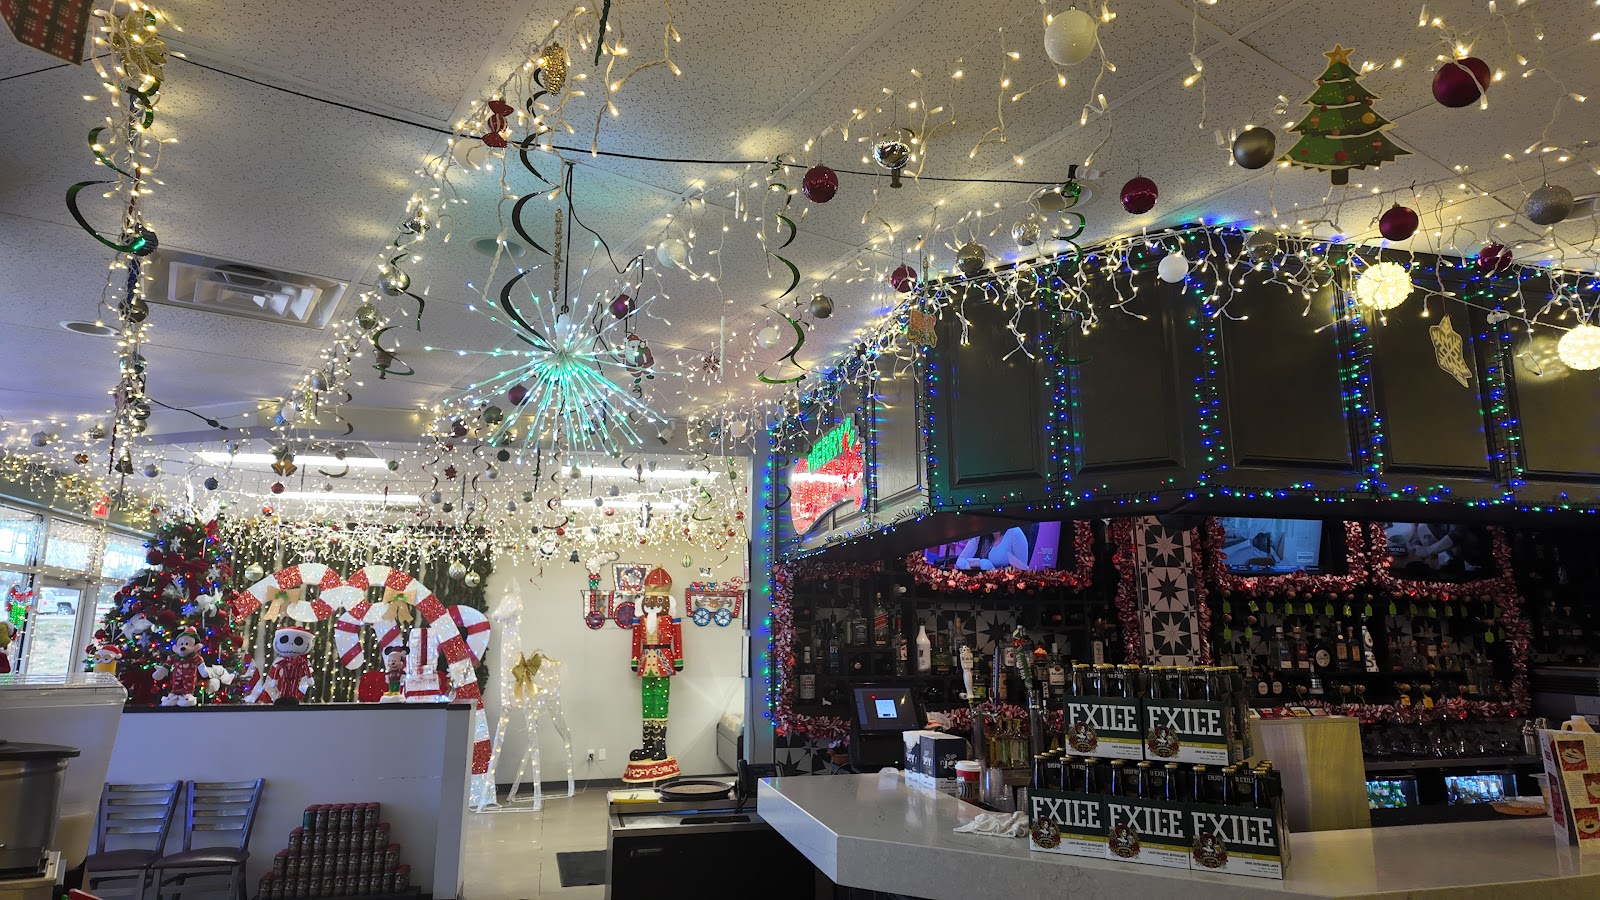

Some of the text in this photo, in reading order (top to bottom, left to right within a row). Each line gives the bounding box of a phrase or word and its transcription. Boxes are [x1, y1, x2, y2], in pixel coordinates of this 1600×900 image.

[1067, 703, 1139, 732] EXILE
[1147, 705, 1224, 737] EXILE
[1030, 796, 1102, 829] EXILE
[1107, 803, 1186, 839] EXILE
[1191, 811, 1276, 848] EXILE
